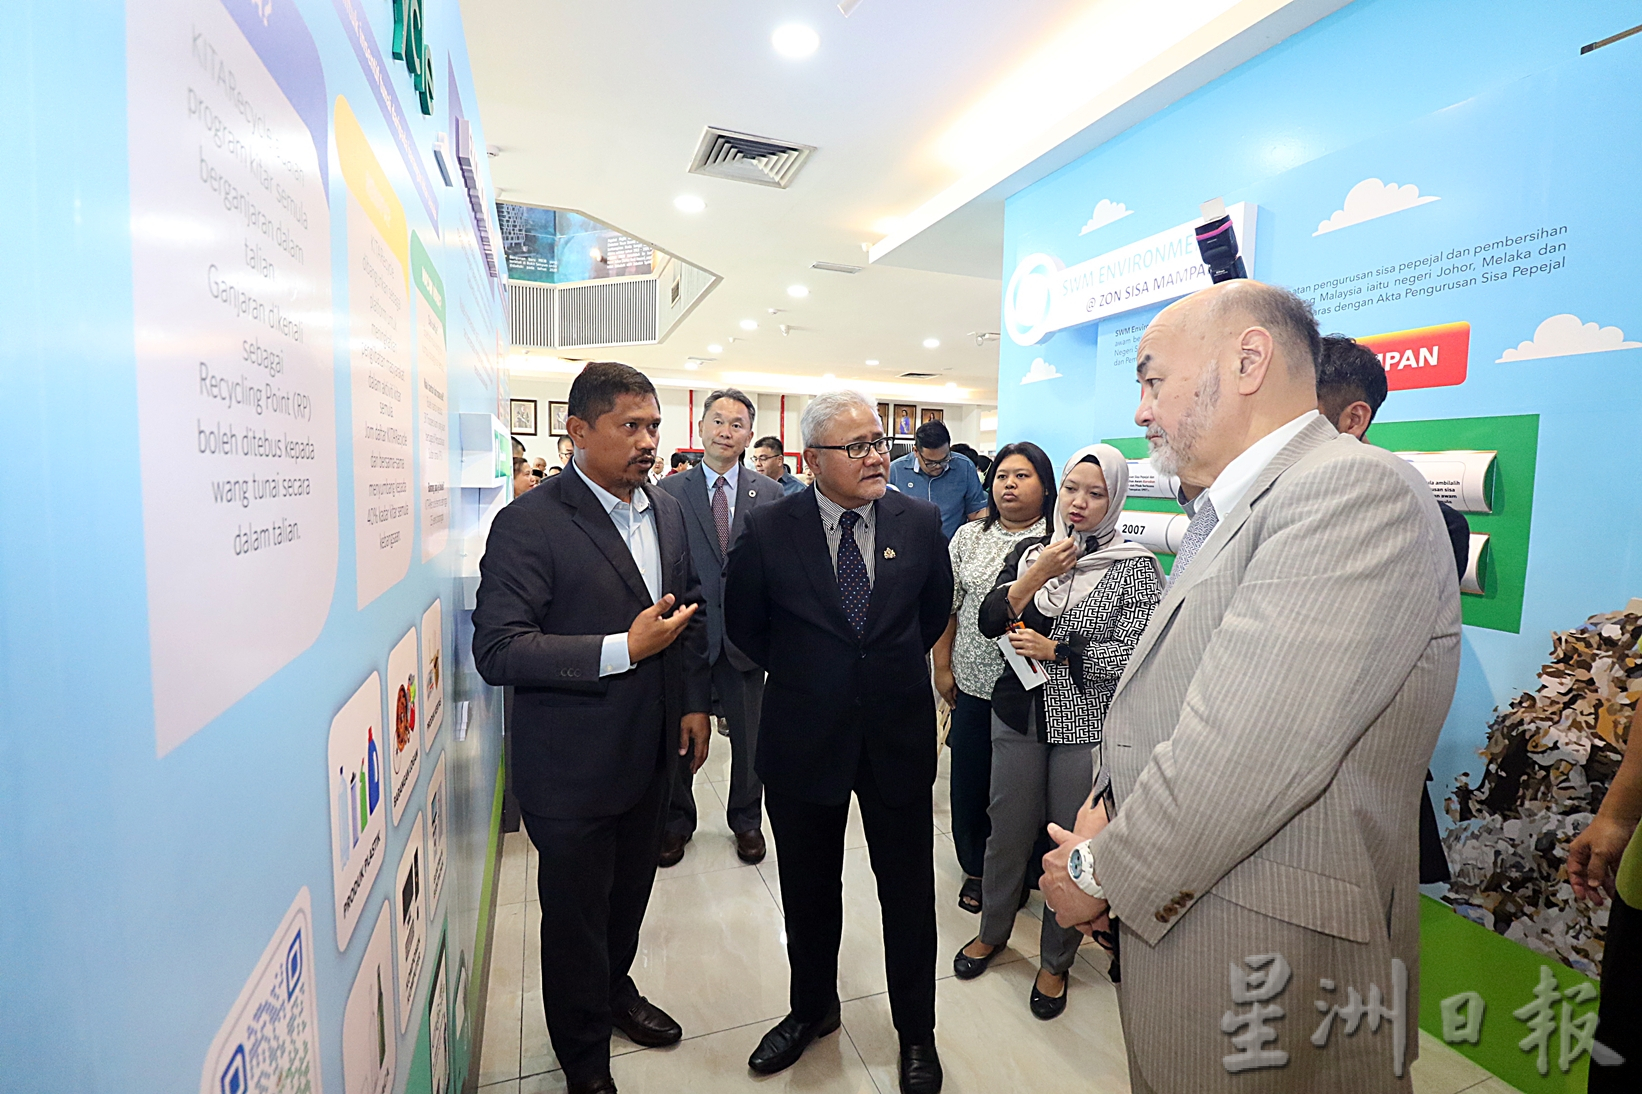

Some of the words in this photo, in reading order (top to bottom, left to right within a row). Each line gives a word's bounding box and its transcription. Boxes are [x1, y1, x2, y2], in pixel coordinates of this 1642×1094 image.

[187, 86, 247, 168] program
[250, 145, 273, 194] kitar
[276, 183, 308, 230] semula
[199, 145, 274, 241] berganjaran
[276, 221, 304, 266] dalam
[245, 238, 275, 282] talian
[1062, 271, 1095, 297] SWM
[1099, 233, 1198, 284] ENVIRONME
[1099, 289, 1122, 307] ZON
[1125, 281, 1150, 300] SISA
[1152, 263, 1210, 291] MAMPA
[1313, 270, 1373, 293] pengurusan
[1375, 265, 1396, 277] sisa
[1398, 251, 1443, 274] pepejal
[1446, 248, 1470, 260] dan
[1473, 225, 1568, 257] pembersihan
[1319, 287, 1362, 303] Malaysia
[1366, 280, 1389, 293] iaitu
[1394, 269, 1432, 287] negeri
[1436, 262, 1476, 278] Johor,
[1482, 249, 1532, 268] Melaka
[1538, 242, 1567, 257] dan
[1334, 298, 1374, 313] dengan
[1376, 292, 1401, 304] Akta
[1405, 277, 1477, 298] Pengurusan
[1481, 271, 1508, 284] Sisa
[1512, 256, 1567, 278] Pepejal
[208, 263, 265, 324] Ganjaran
[268, 303, 304, 344] dikenali
[1115, 327, 1131, 337] SWM
[243, 336, 284, 377] sebagai
[199, 361, 263, 415] Recycling
[265, 383, 290, 416] Point
[292, 392, 312, 422] (RP)
[197, 418, 238, 455] boleh
[242, 426, 282, 458] ditebus
[284, 432, 315, 464] kepada
[211, 479, 249, 508] wang
[252, 470, 280, 500] tunai
[282, 478, 311, 497] secara
[234, 523, 271, 556] dalam
[272, 517, 301, 546] talian.
[1122, 524, 1146, 536] 2007
[343, 865, 366, 920] PRODUK
[363, 830, 382, 873] PLASTIK
